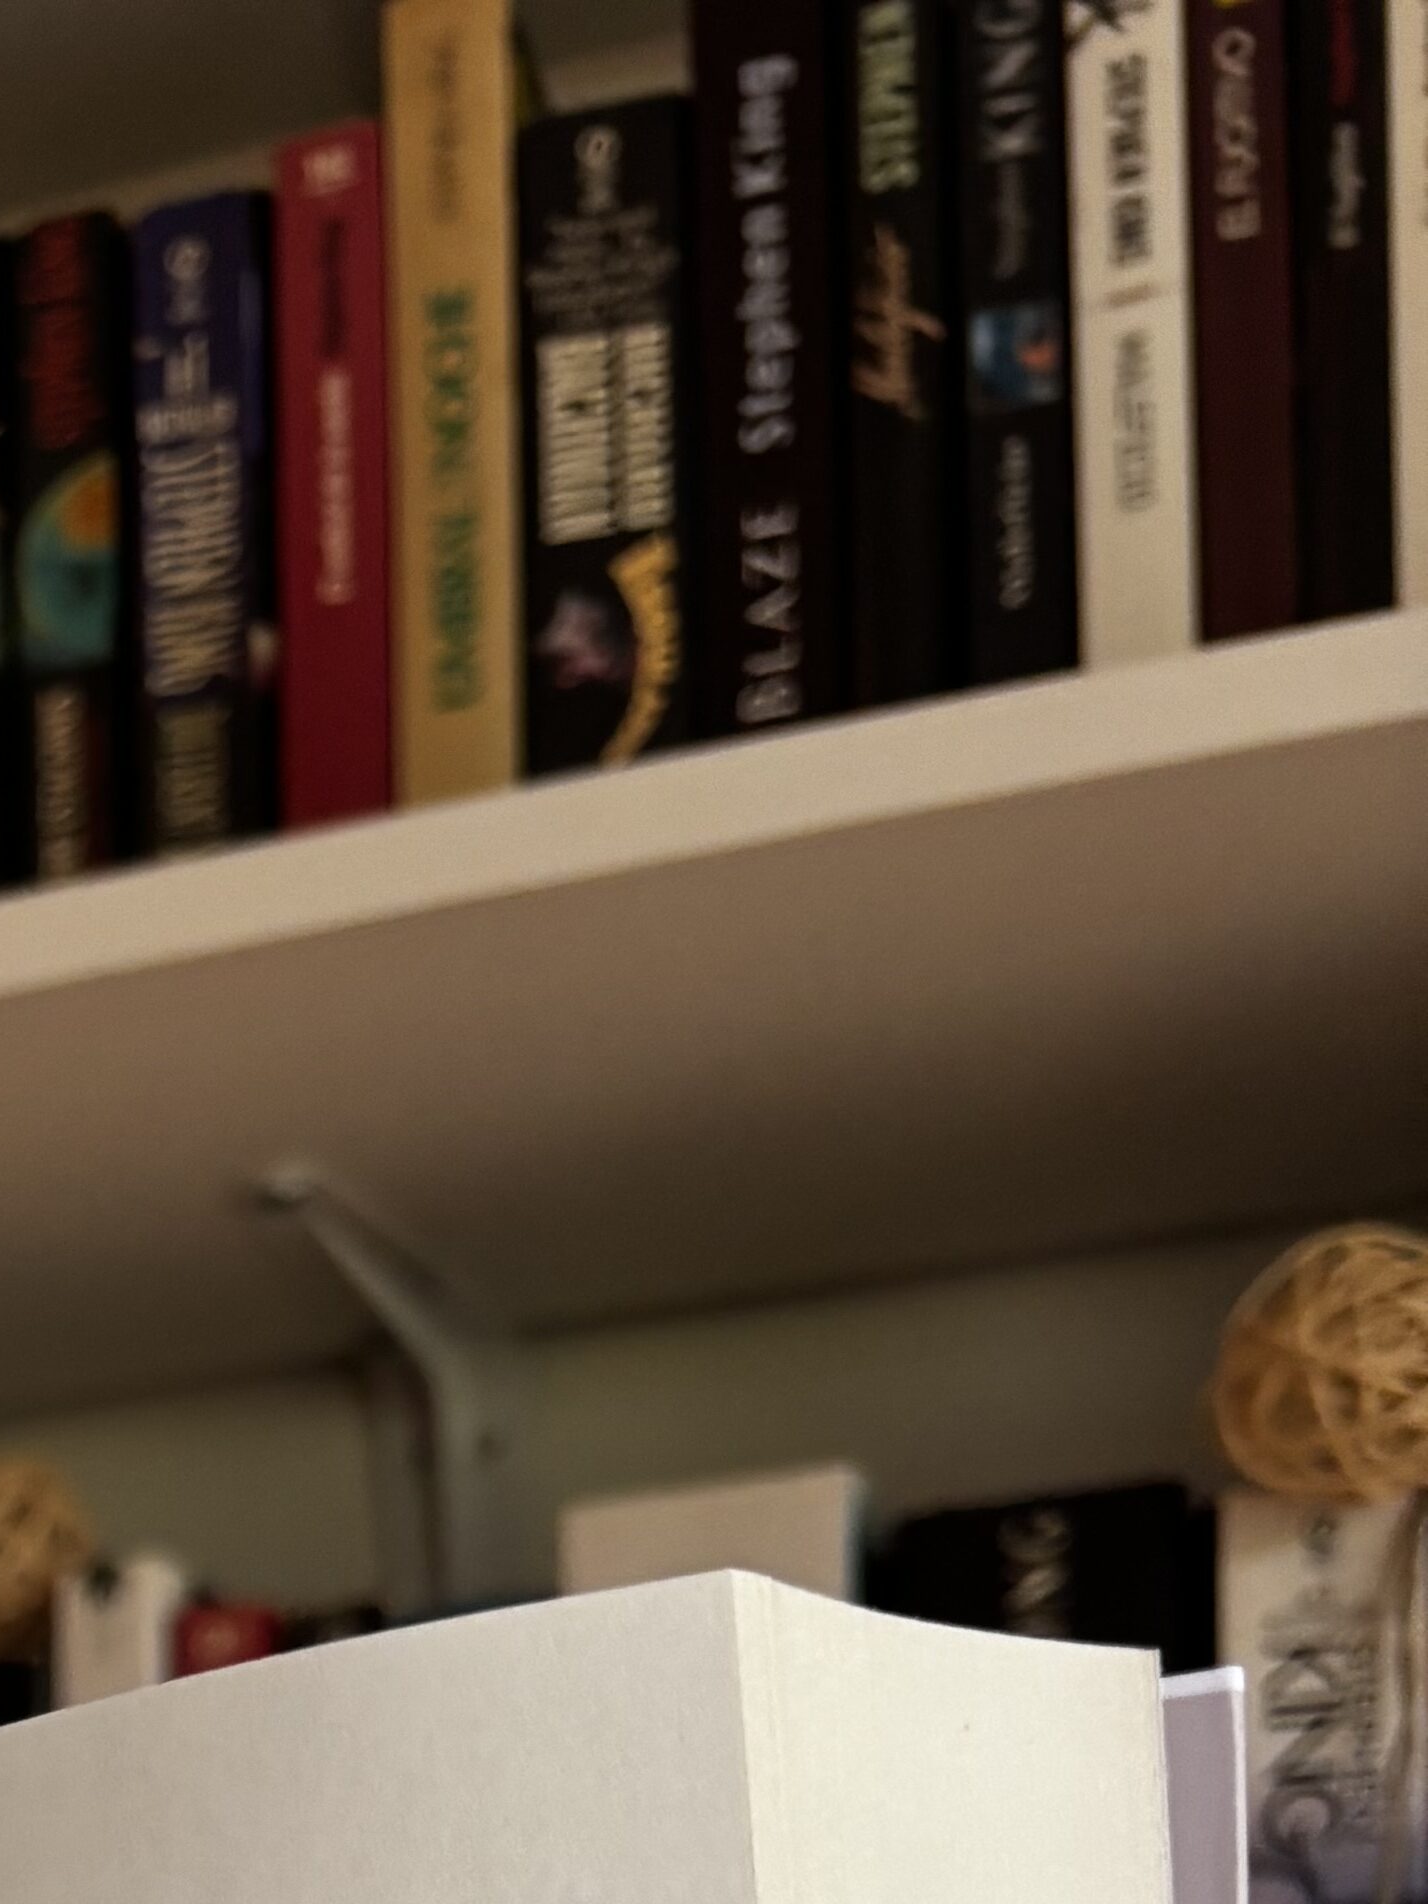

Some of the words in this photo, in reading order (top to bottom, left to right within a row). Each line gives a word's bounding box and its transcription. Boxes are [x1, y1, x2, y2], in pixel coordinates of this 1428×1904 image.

[734, 52, 799, 199] King
[737, 201, 800, 456] Stephen
[737, 499, 801, 726] BLAZE
